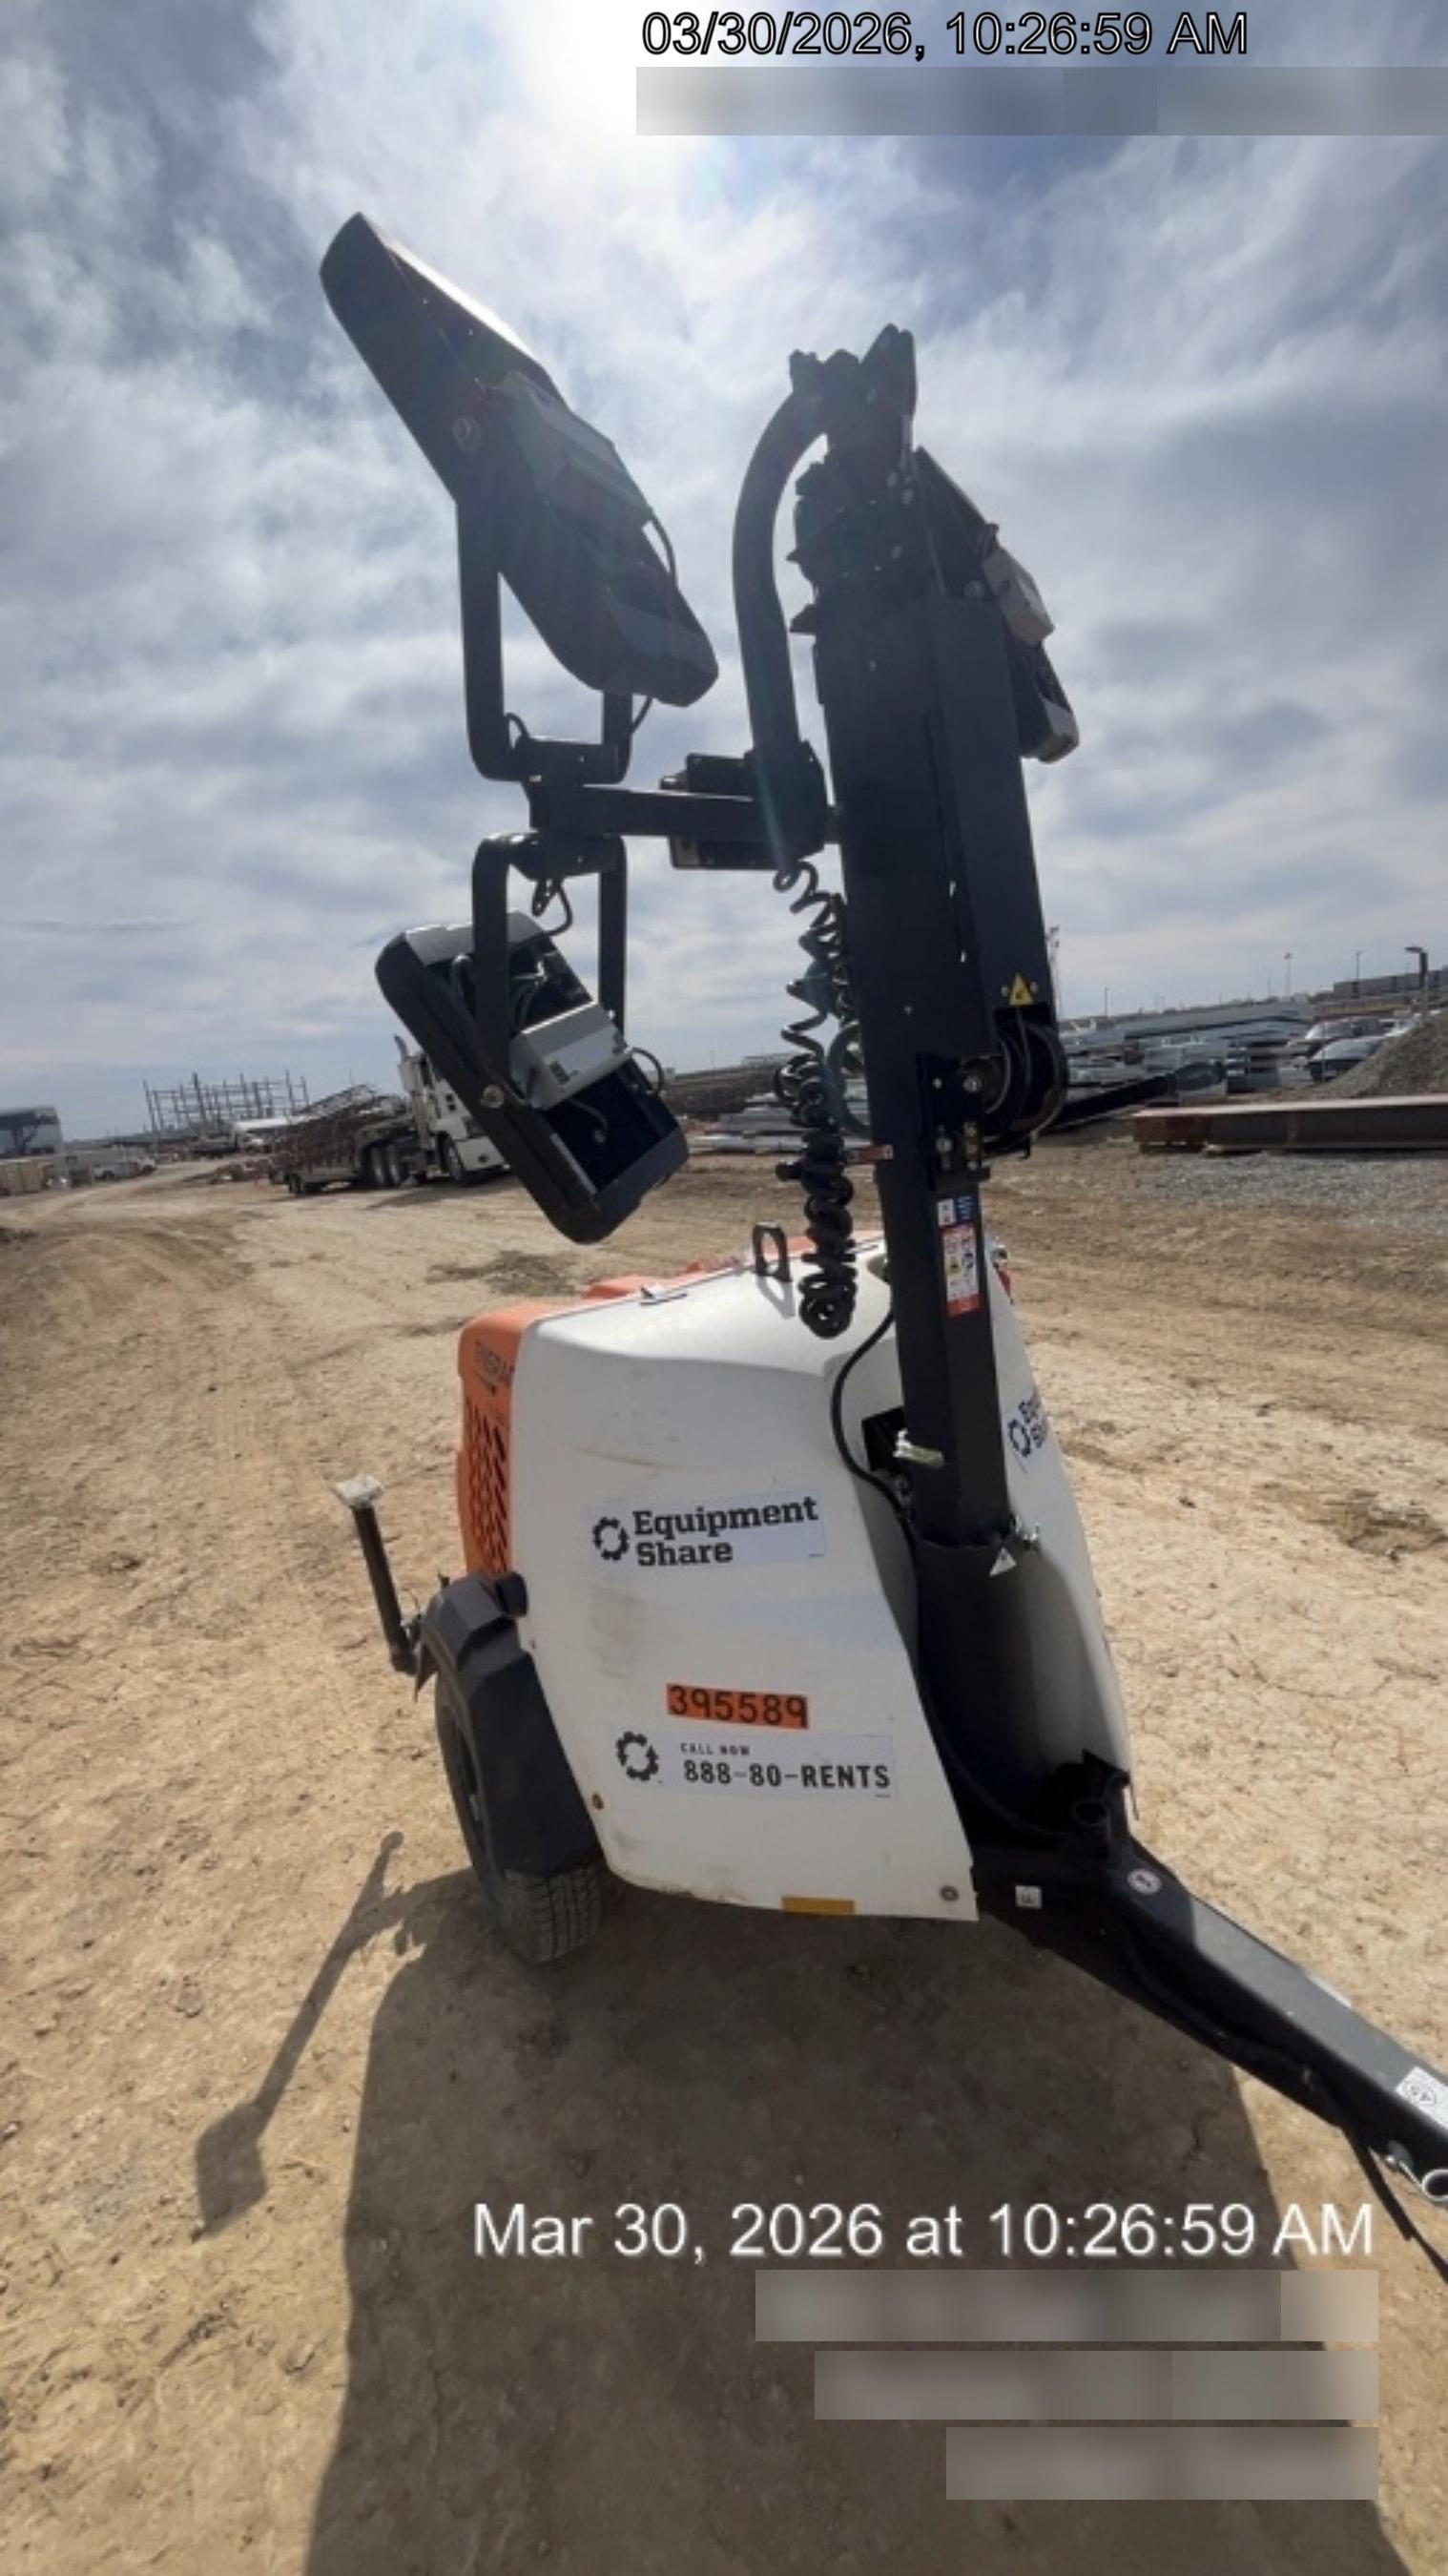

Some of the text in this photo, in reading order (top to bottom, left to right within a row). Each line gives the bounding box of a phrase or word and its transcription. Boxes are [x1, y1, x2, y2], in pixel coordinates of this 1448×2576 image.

[632, 1496, 818, 1540] Equipment
[636, 1542, 733, 1567] Share
[669, 1685, 808, 1728] 395589
[680, 1742, 714, 1755] CALL
[684, 1760, 890, 1789] 888-80-RENTS
